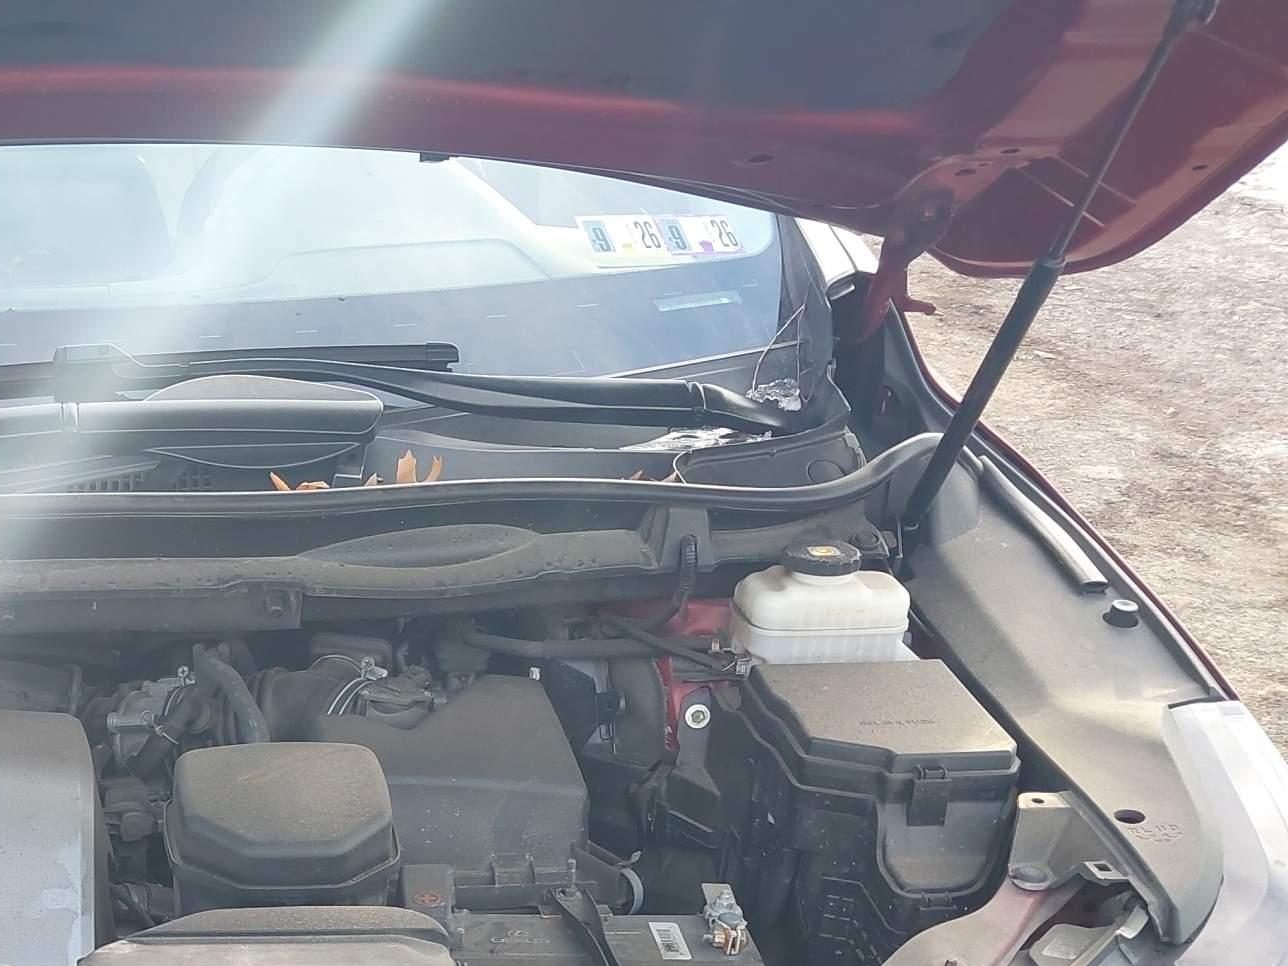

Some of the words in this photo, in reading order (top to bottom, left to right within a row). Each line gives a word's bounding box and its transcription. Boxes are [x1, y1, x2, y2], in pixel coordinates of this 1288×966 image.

[592, 227, 611, 252] 9
[633, 221, 662, 249] 26
[668, 224, 688, 250] 9
[710, 219, 739, 248] 26
